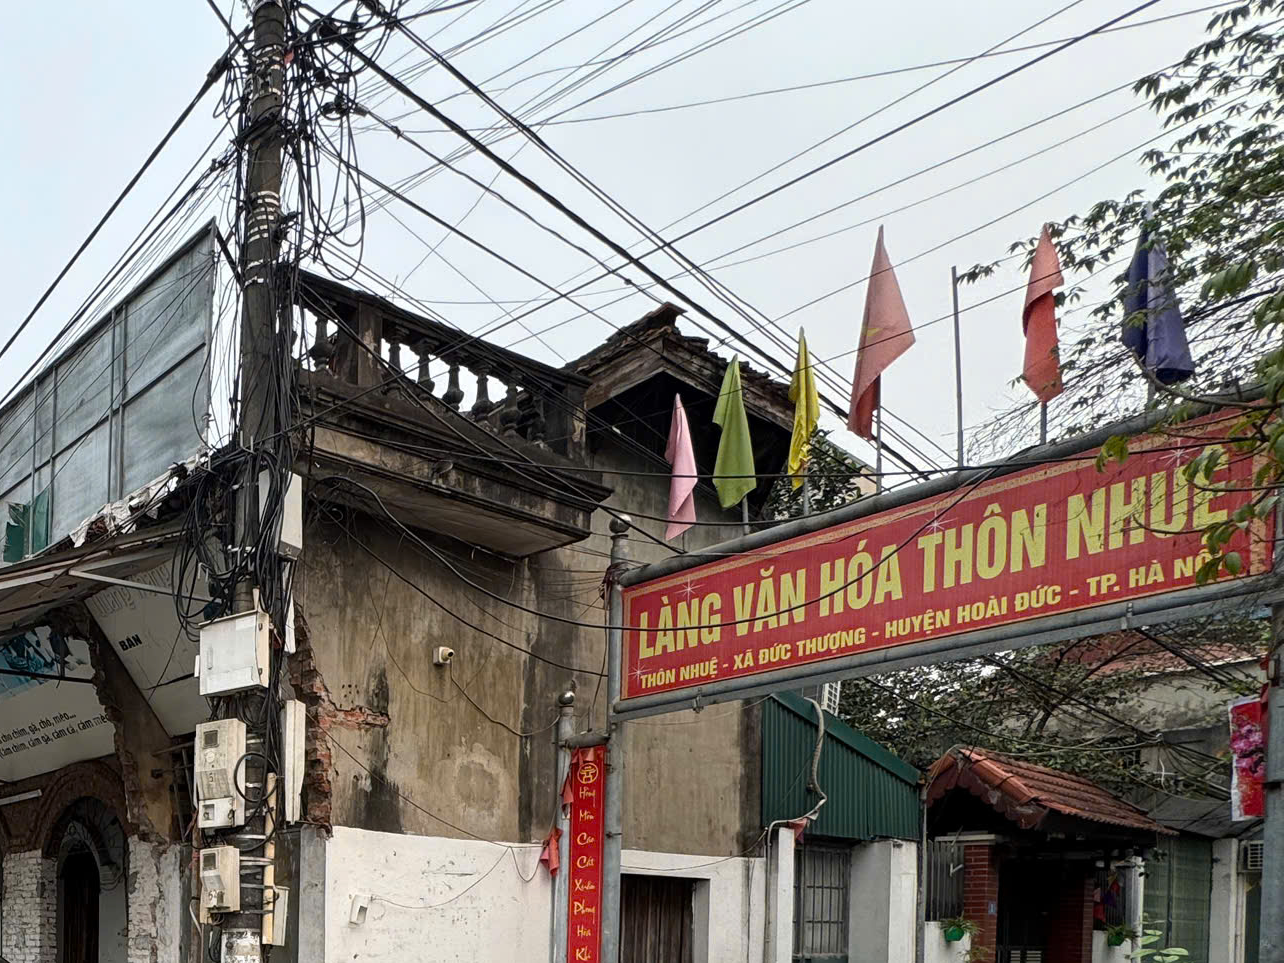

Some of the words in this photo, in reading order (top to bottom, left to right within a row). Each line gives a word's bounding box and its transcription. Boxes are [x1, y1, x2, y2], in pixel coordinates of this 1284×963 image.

[638, 593, 722, 660] LÀNG
[733, 565, 806, 637] VĂN
[819, 539, 903, 617] HÓA
[917, 503, 1047, 594] THÔN
[1066, 444, 1229, 560] NHUỆ
[640, 663, 676, 689] THÔN
[679, 656, 718, 681] NHUỆ
[733, 649, 755, 671] XÃ
[758, 642, 792, 665] ĐỨC
[796, 627, 866, 657] THƯỢNG
[885, 608, 951, 639] HUYỆN
[957, 595, 1008, 624] HOÀI
[1014, 584, 1062, 612] ĐỨC
[1086, 573, 1120, 597] TP.
[1129, 560, 1165, 588] HÀ
